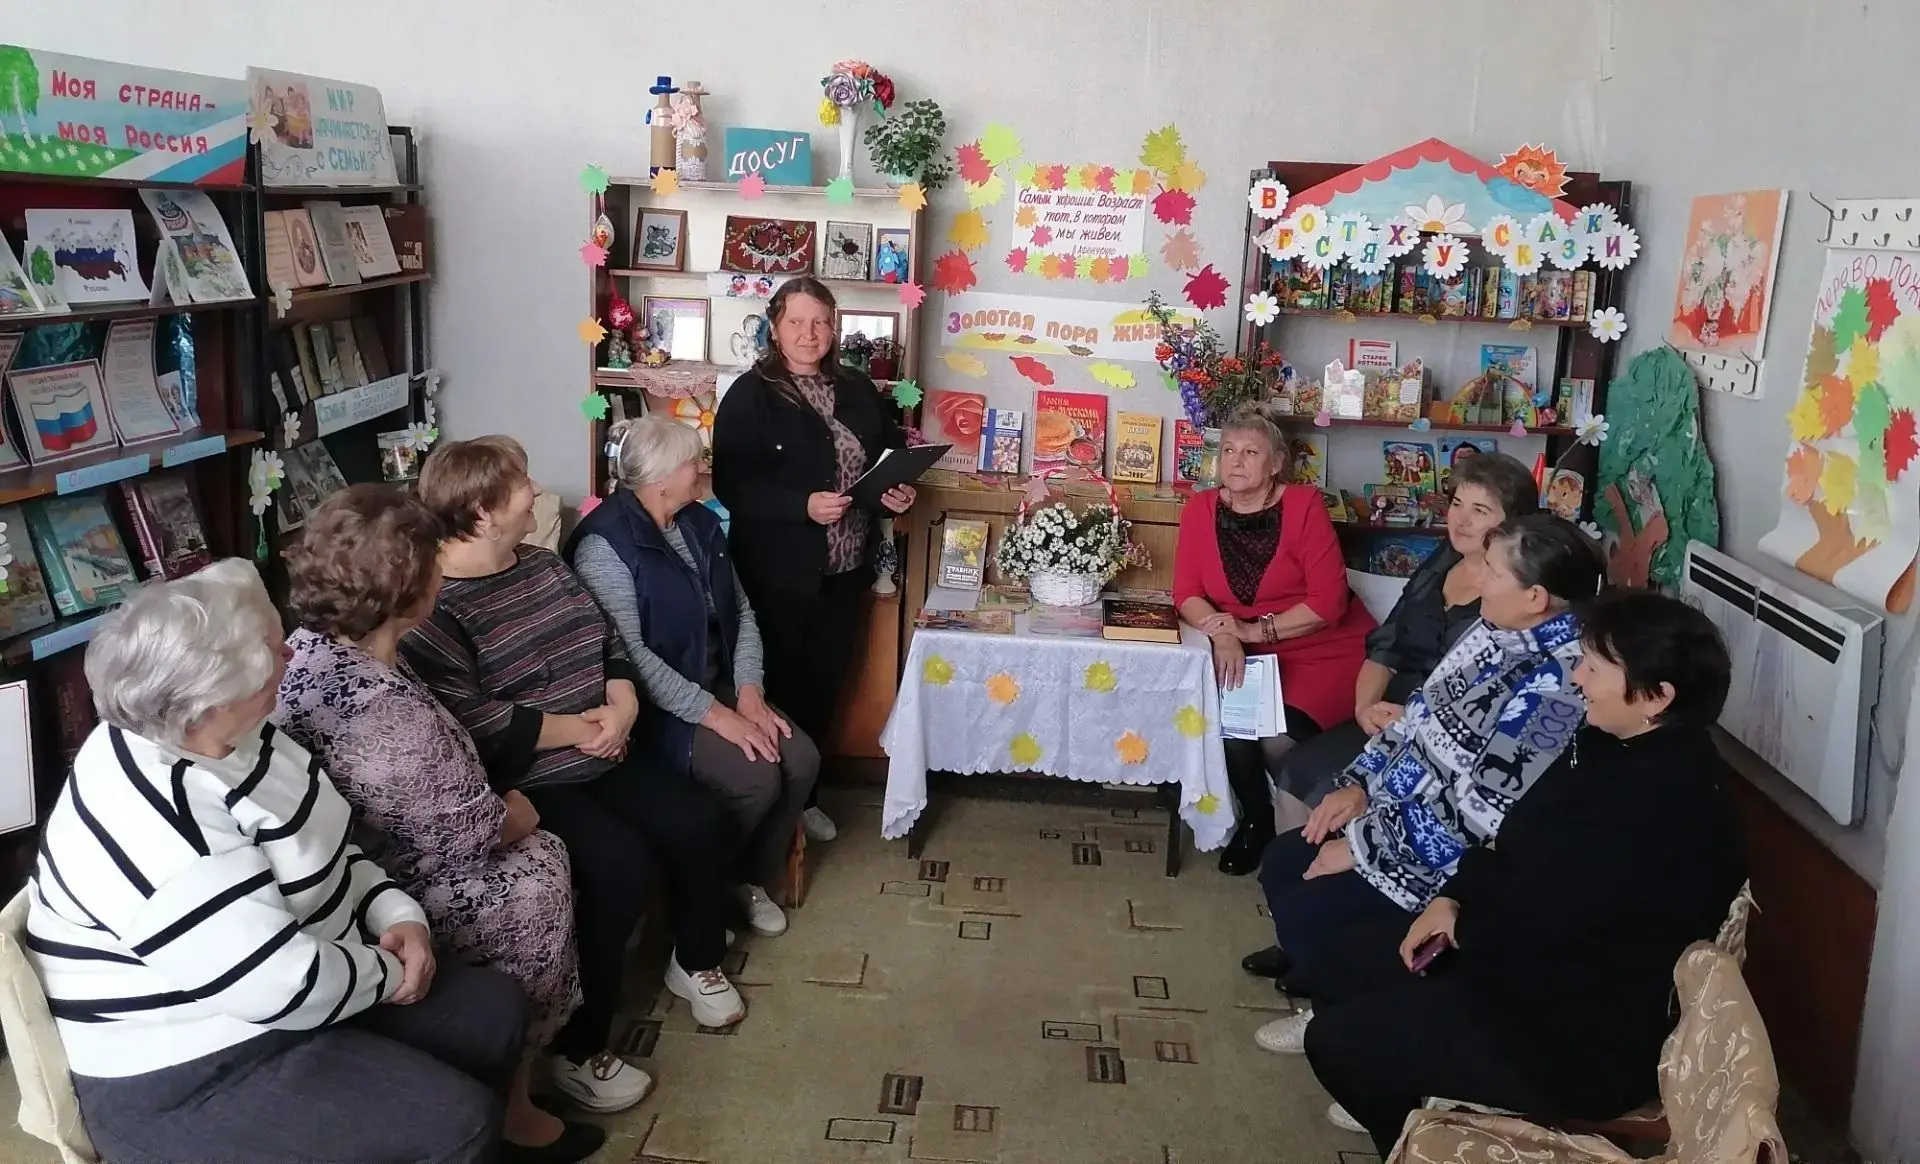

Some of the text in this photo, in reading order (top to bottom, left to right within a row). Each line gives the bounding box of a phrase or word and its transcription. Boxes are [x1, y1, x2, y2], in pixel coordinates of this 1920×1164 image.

[326, 87, 354, 113] МИР
[729, 137, 804, 179] ДОСУГ
[1262, 187, 1277, 209] В
[1083, 213, 1126, 226] котором
[947, 310, 1178, 343] ЗОЛОТАЯ ПОРА ЖИЗ
[946, 566, 979, 576] ТРАВНИК
